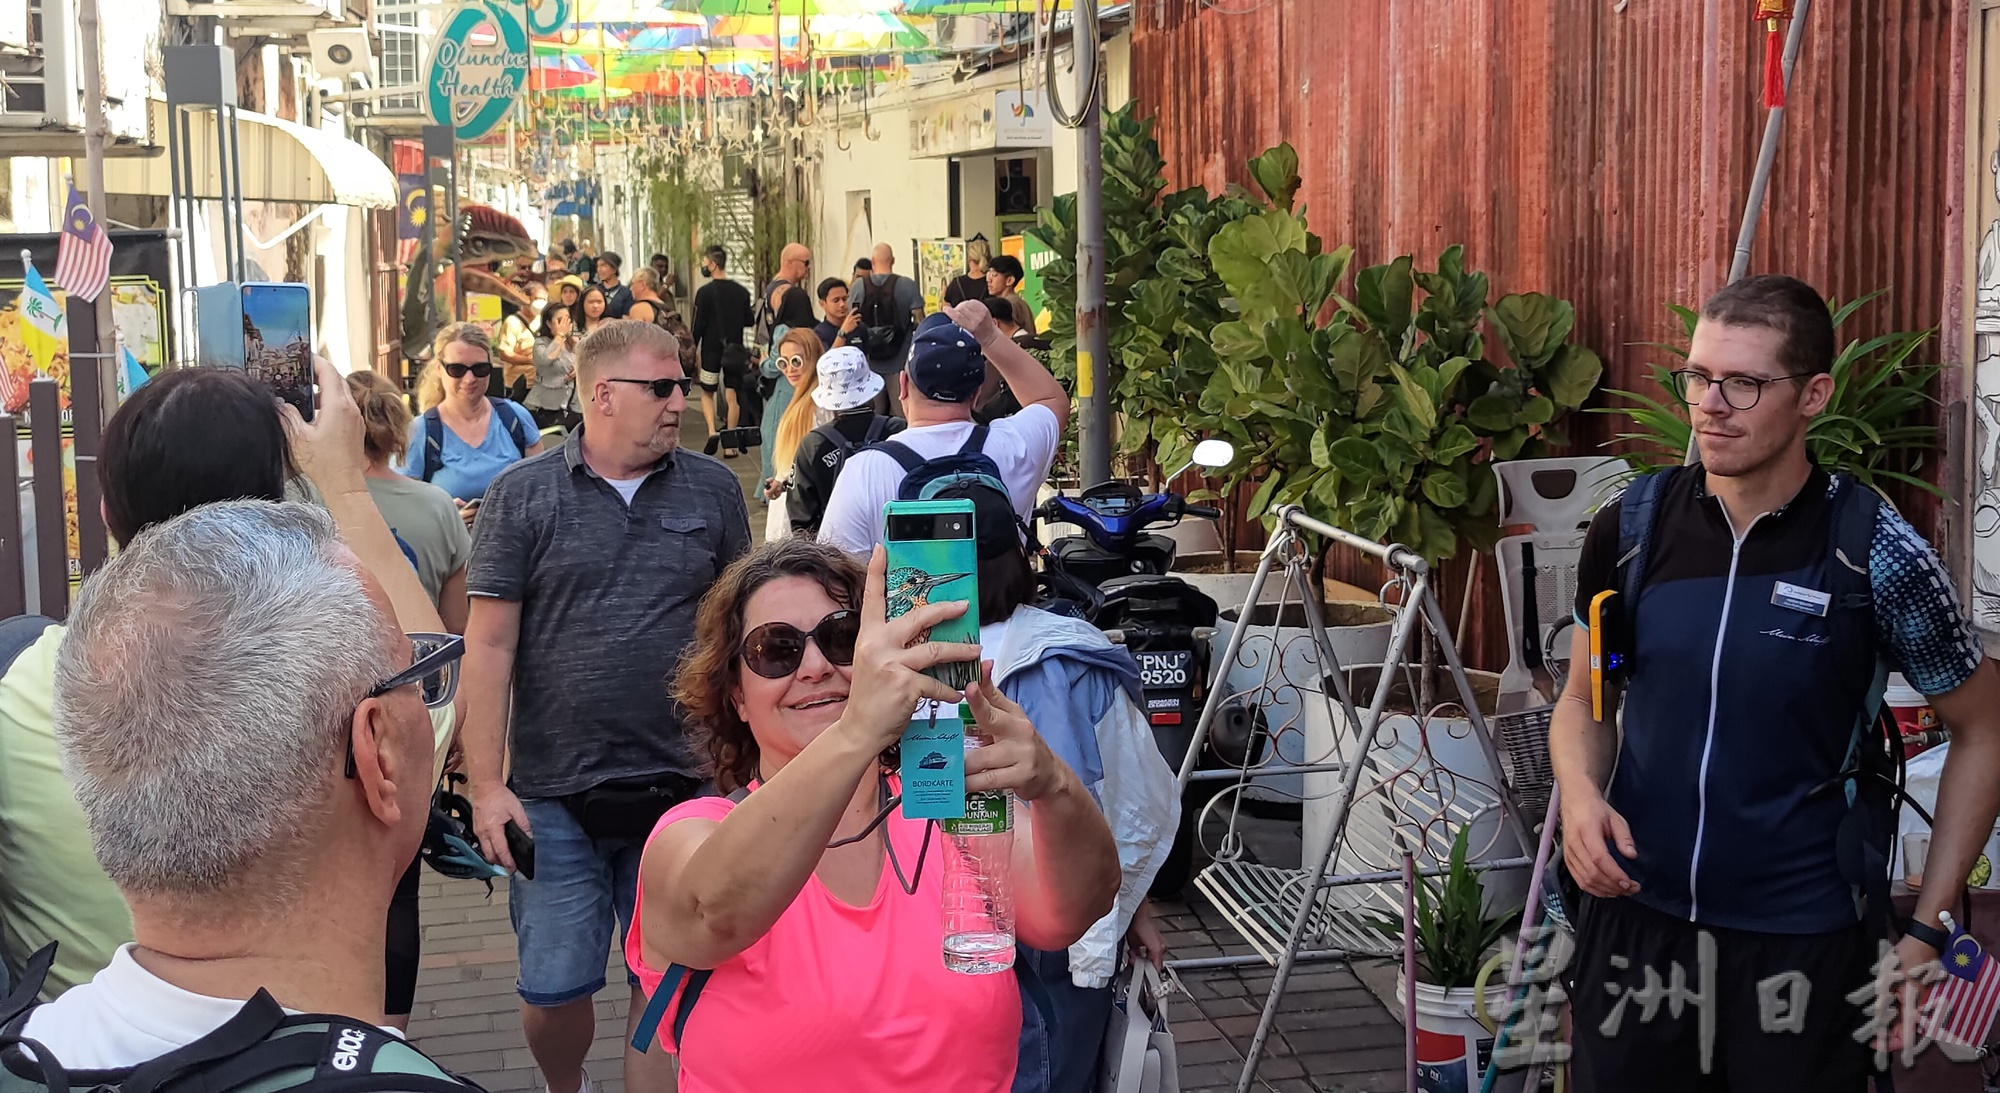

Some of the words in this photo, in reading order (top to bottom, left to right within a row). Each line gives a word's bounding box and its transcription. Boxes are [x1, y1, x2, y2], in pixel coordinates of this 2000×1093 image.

[437, 39, 529, 67] Olundus
[438, 68, 514, 98] Health
[1143, 655, 1179, 669] PNJ
[1140, 669, 1186, 684] 9520
[912, 779, 954, 788] BORDKARTE
[966, 800, 986, 810] ICE
[332, 1028, 367, 1071] evoc
